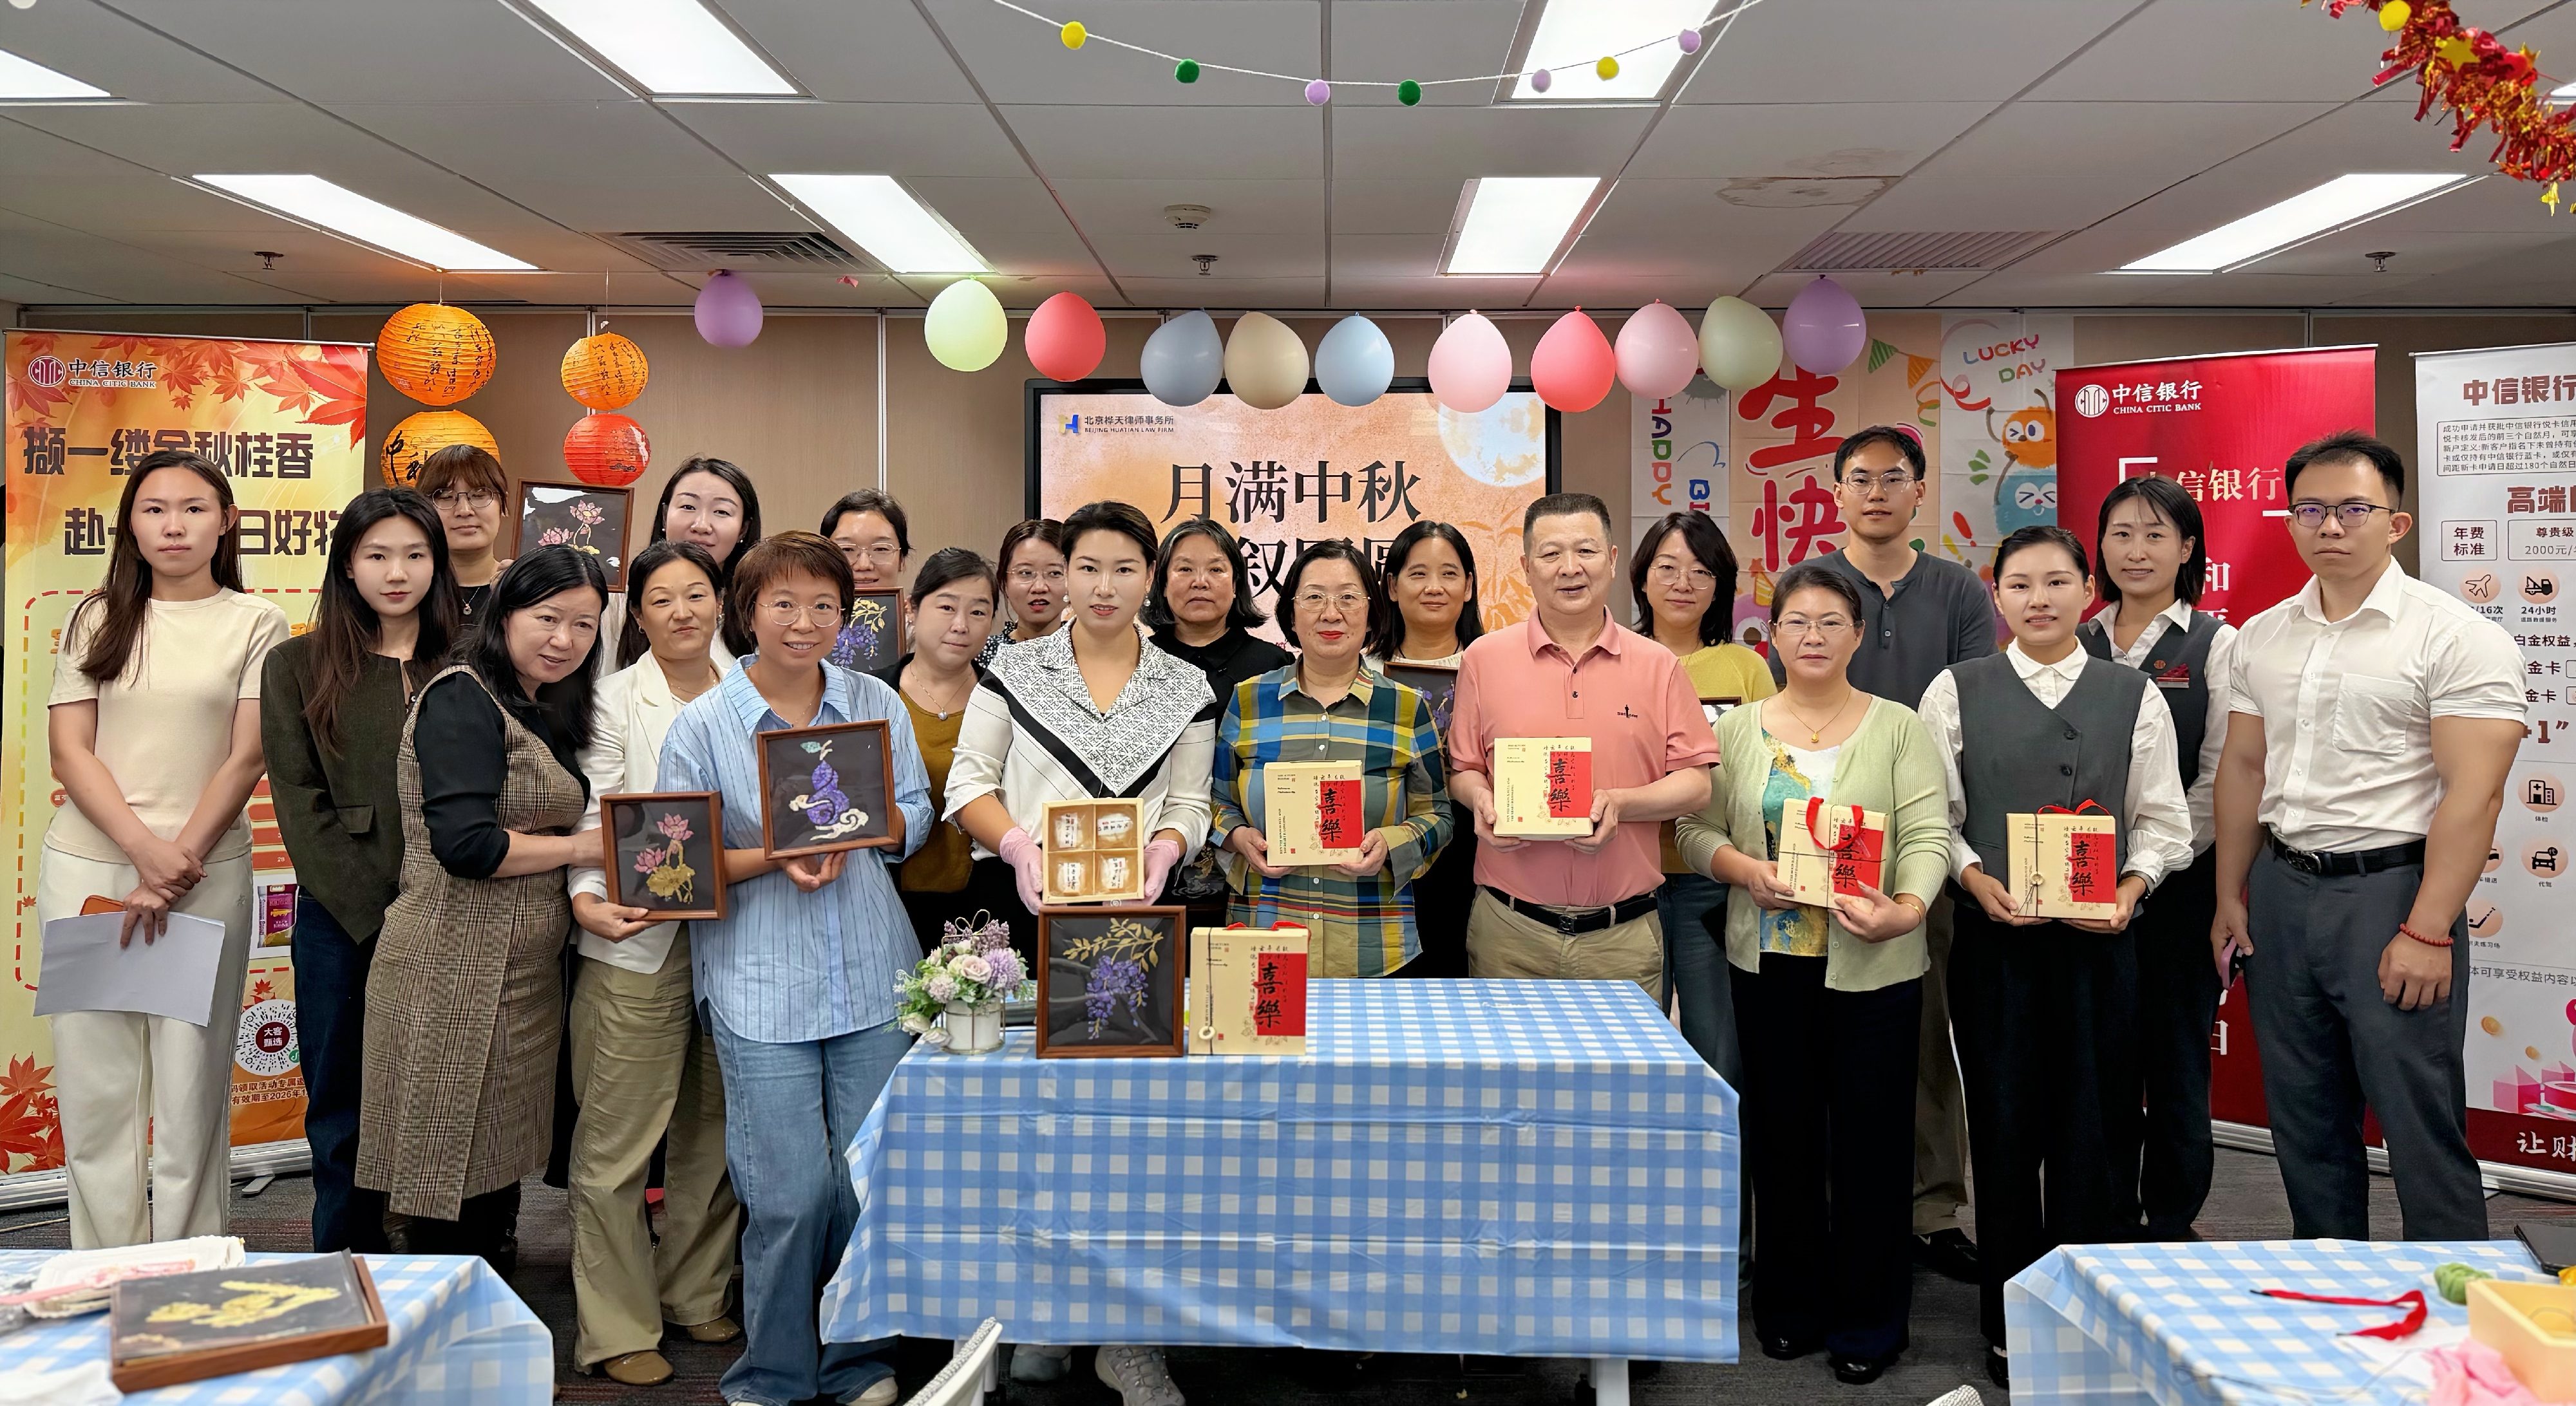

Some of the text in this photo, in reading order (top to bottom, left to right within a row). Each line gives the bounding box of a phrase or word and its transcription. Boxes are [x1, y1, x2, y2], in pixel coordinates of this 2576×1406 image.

[1963, 334, 2039, 364] LUCKY
[69, 358, 156, 379] 中信银行
[1999, 359, 2045, 384] DAY
[2112, 380, 2202, 404] 中信银行
[2463, 375, 2576, 406] 中信银行
[1084, 415, 1174, 425] 北京桦天律师事务所
[1738, 364, 1846, 468] 生
[2146, 404, 2172, 413] CITIC
[2175, 403, 2201, 411] BANK
[1160, 460, 1421, 523] 月满中秋
[2150, 467, 2282, 502] 信银行
[2507, 485, 2576, 513] 高端
[1752, 475, 1846, 572] 快
[2454, 527, 2484, 539] 年费
[2536, 527, 2574, 538] 尊贵级
[2454, 543, 2485, 556] 标准
[2525, 545, 2576, 556] 2000元/
[2471, 606, 2503, 614] /16次
[2521, 606, 2556, 615] 24小时
[2514, 634, 2576, 648] 白金权益
[1549, 758, 1571, 812] 喜樂
[1318, 787, 1343, 843] 喜樂
[2069, 840, 2094, 896] 喜樂
[1256, 962, 1283, 1028] 喜樂
